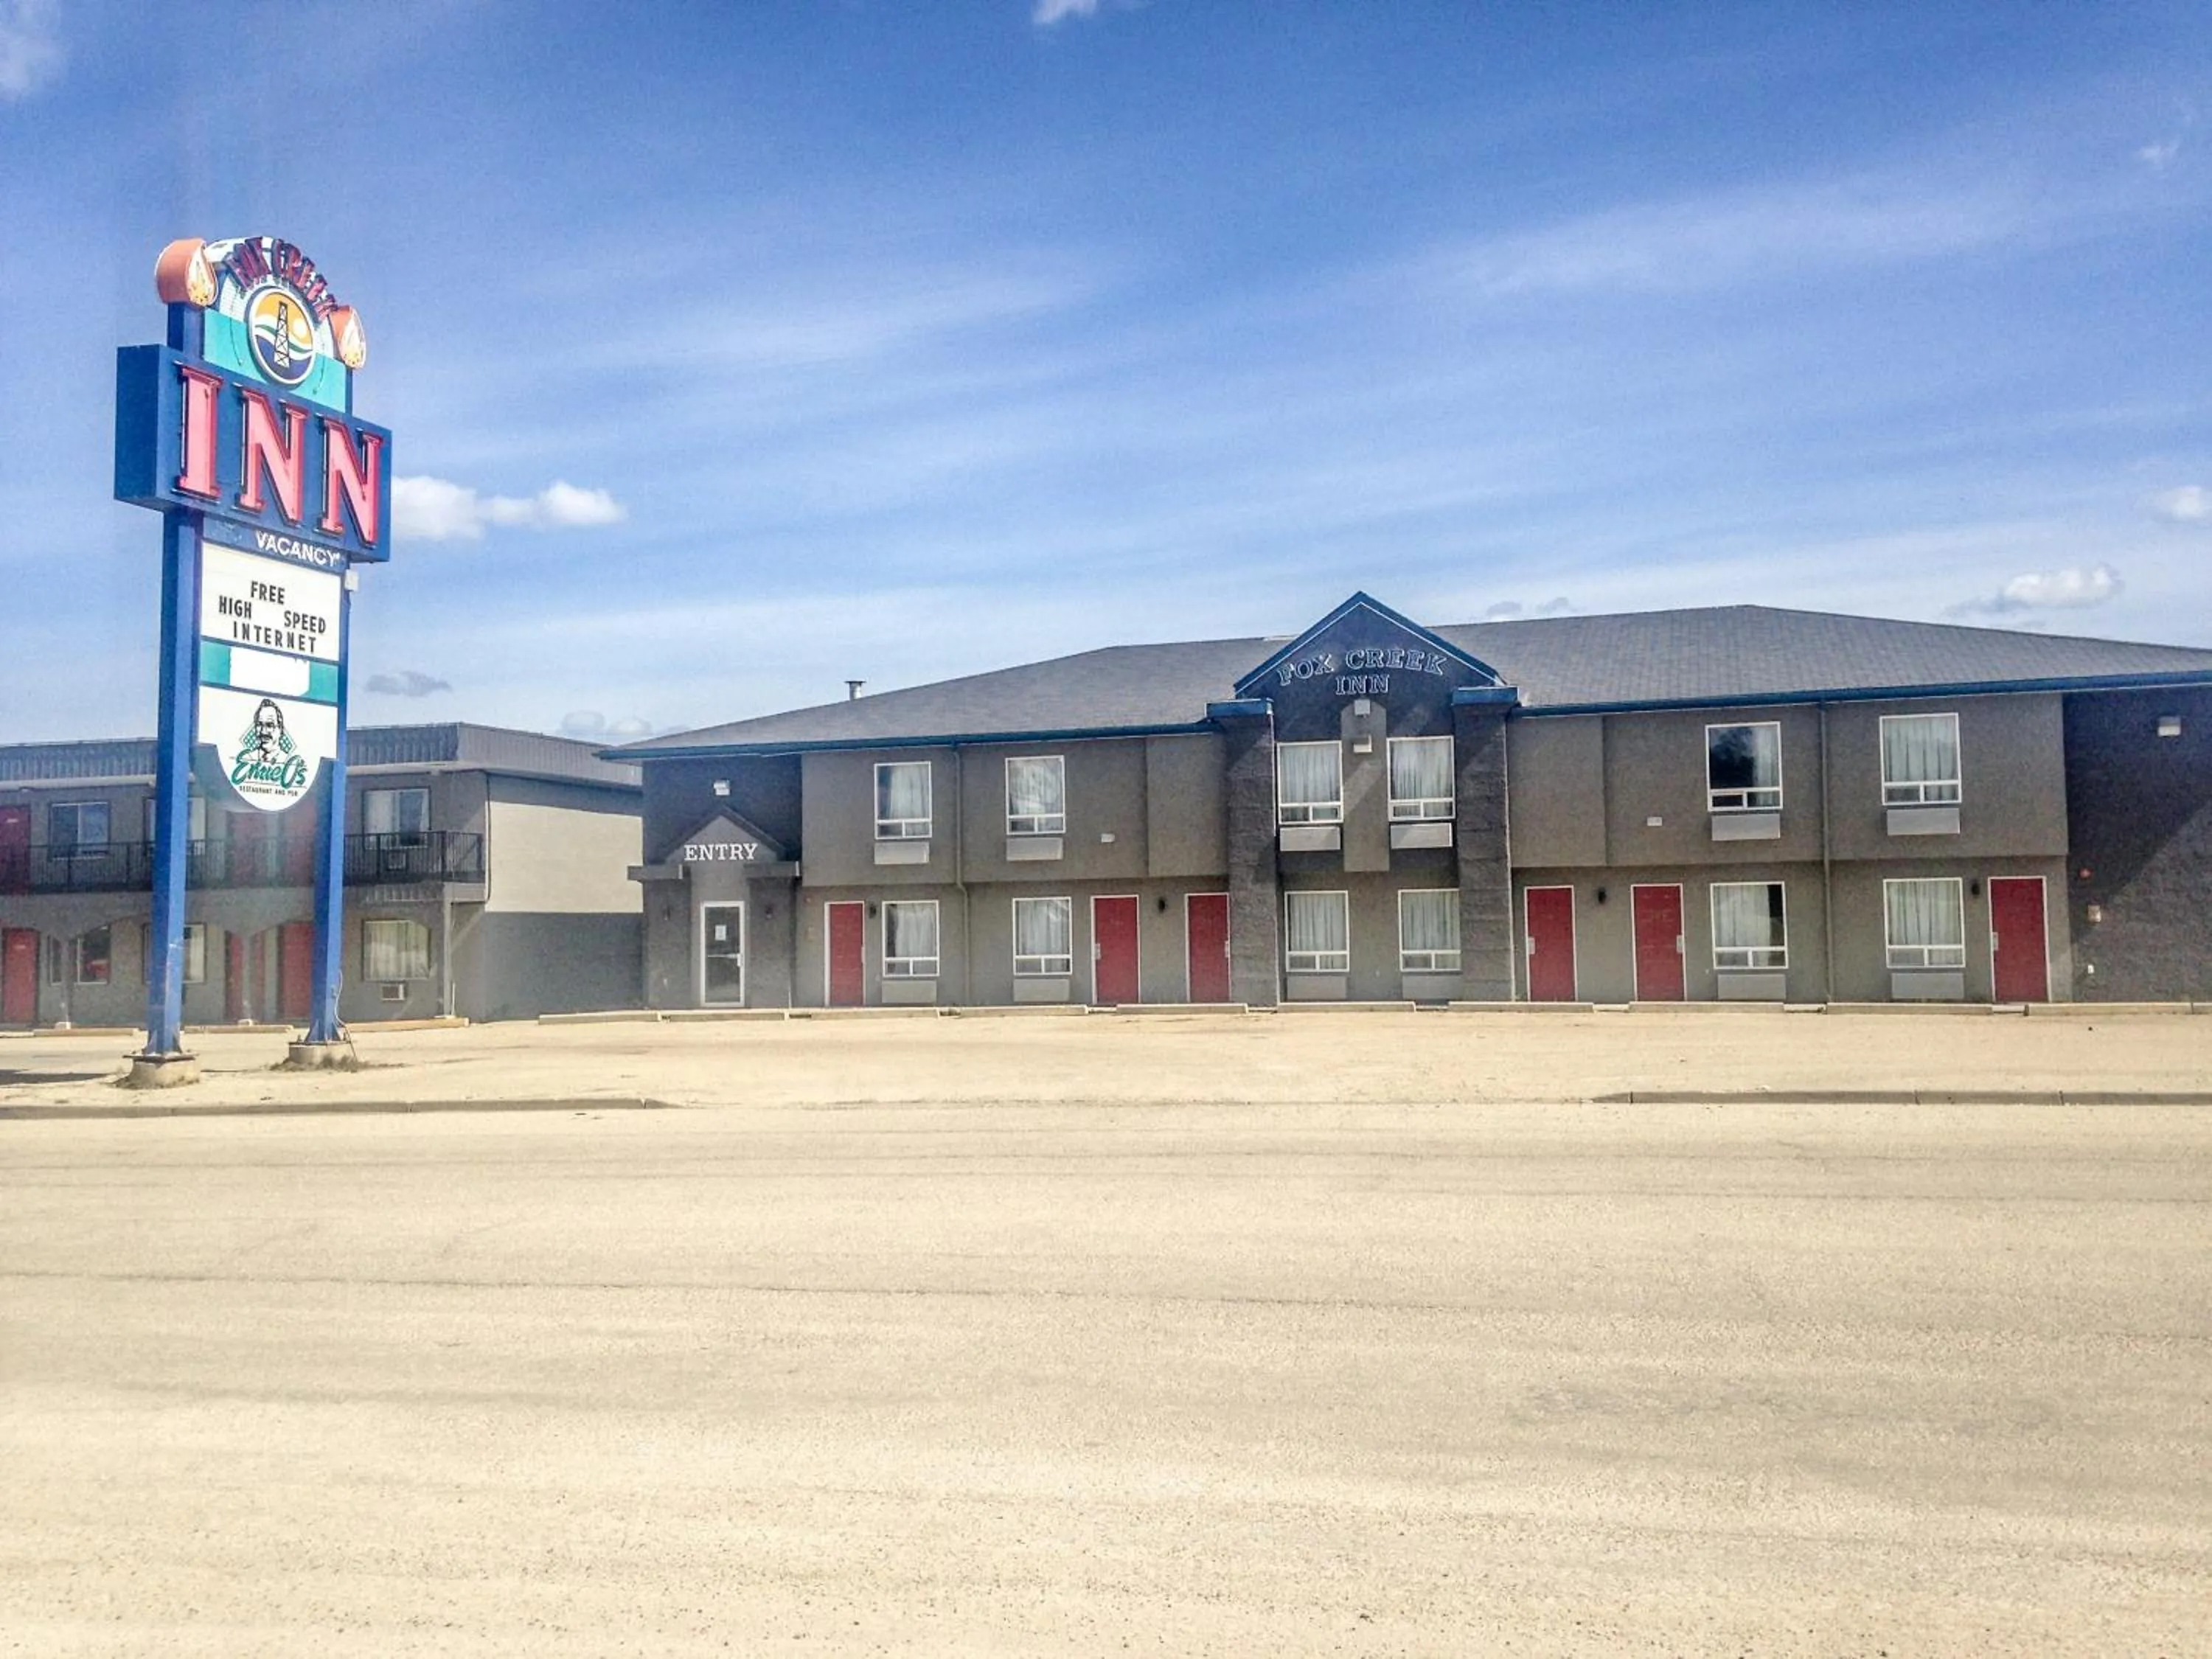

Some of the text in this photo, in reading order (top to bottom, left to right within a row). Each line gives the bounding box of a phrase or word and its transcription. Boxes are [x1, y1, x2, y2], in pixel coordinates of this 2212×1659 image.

[173, 362, 383, 548] INN
[255, 530, 340, 566] VACANCY
[251, 581, 285, 605] FREE
[218, 595, 326, 634] HIGH SPEED
[233, 621, 316, 653] INTERNET
[1276, 649, 1447, 686] FOX CREEK
[1335, 675, 1390, 695] INN
[684, 843, 758, 861] ENTRY
